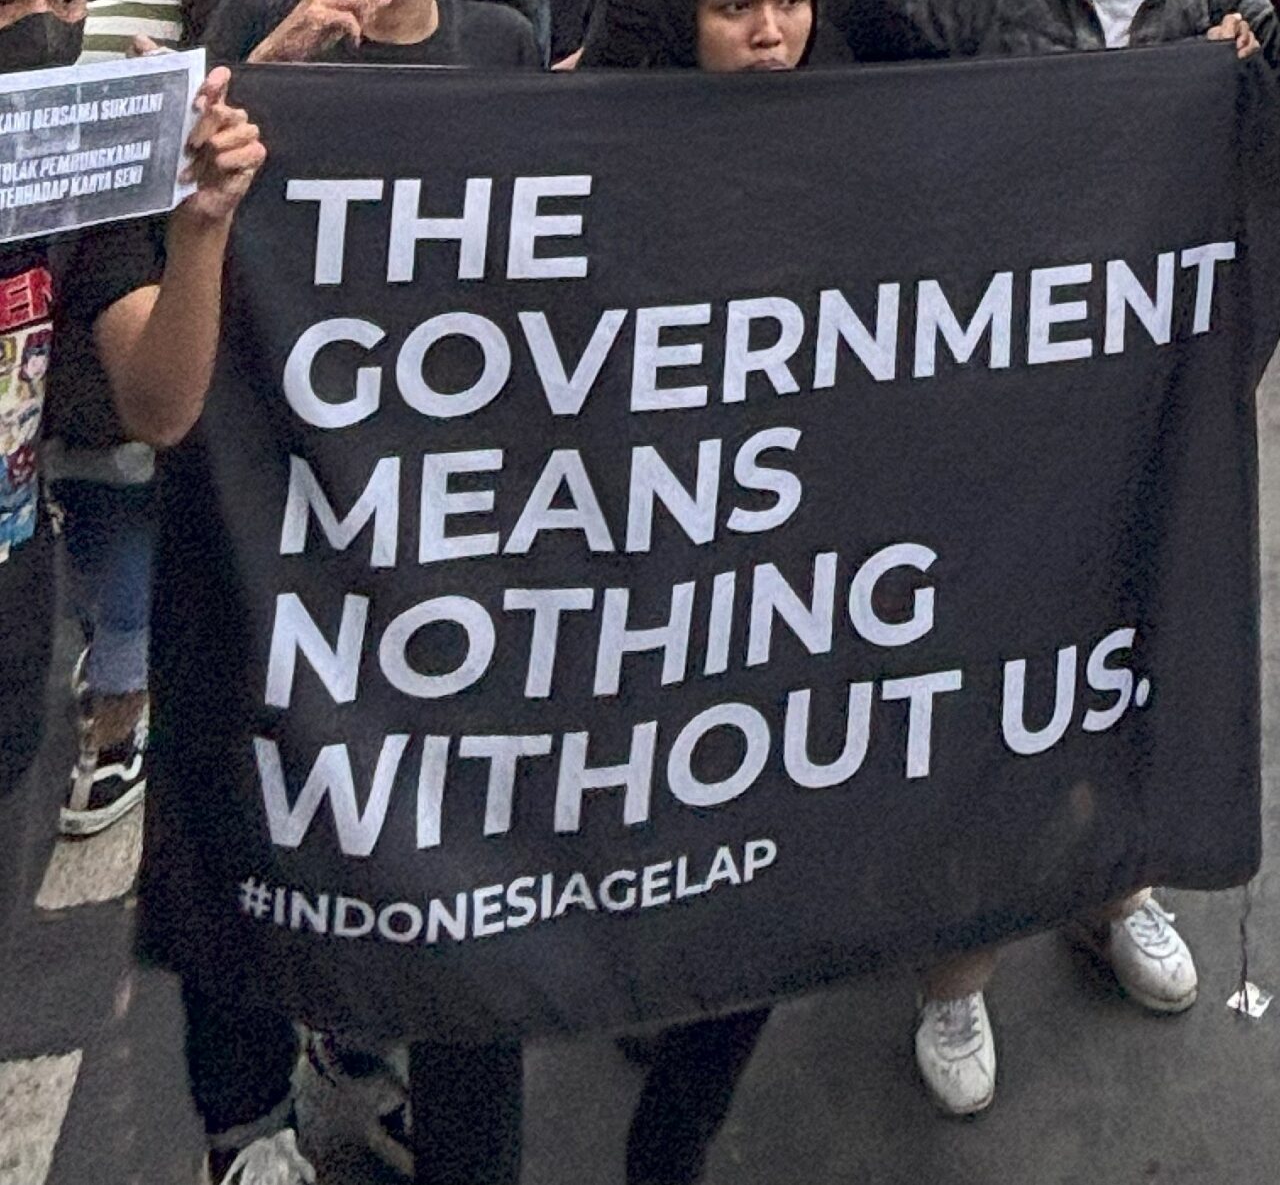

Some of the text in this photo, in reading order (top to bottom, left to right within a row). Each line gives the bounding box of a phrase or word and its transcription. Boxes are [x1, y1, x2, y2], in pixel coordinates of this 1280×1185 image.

[286, 174, 593, 286] THE
[283, 241, 1236, 429] GOVERNMENT
[279, 426, 803, 568] MEANS
[264, 542, 938, 709] NOTHING
[253, 627, 1150, 857] WITHOUT US.
[239, 838, 778, 944] #INDONESIAGELAP
